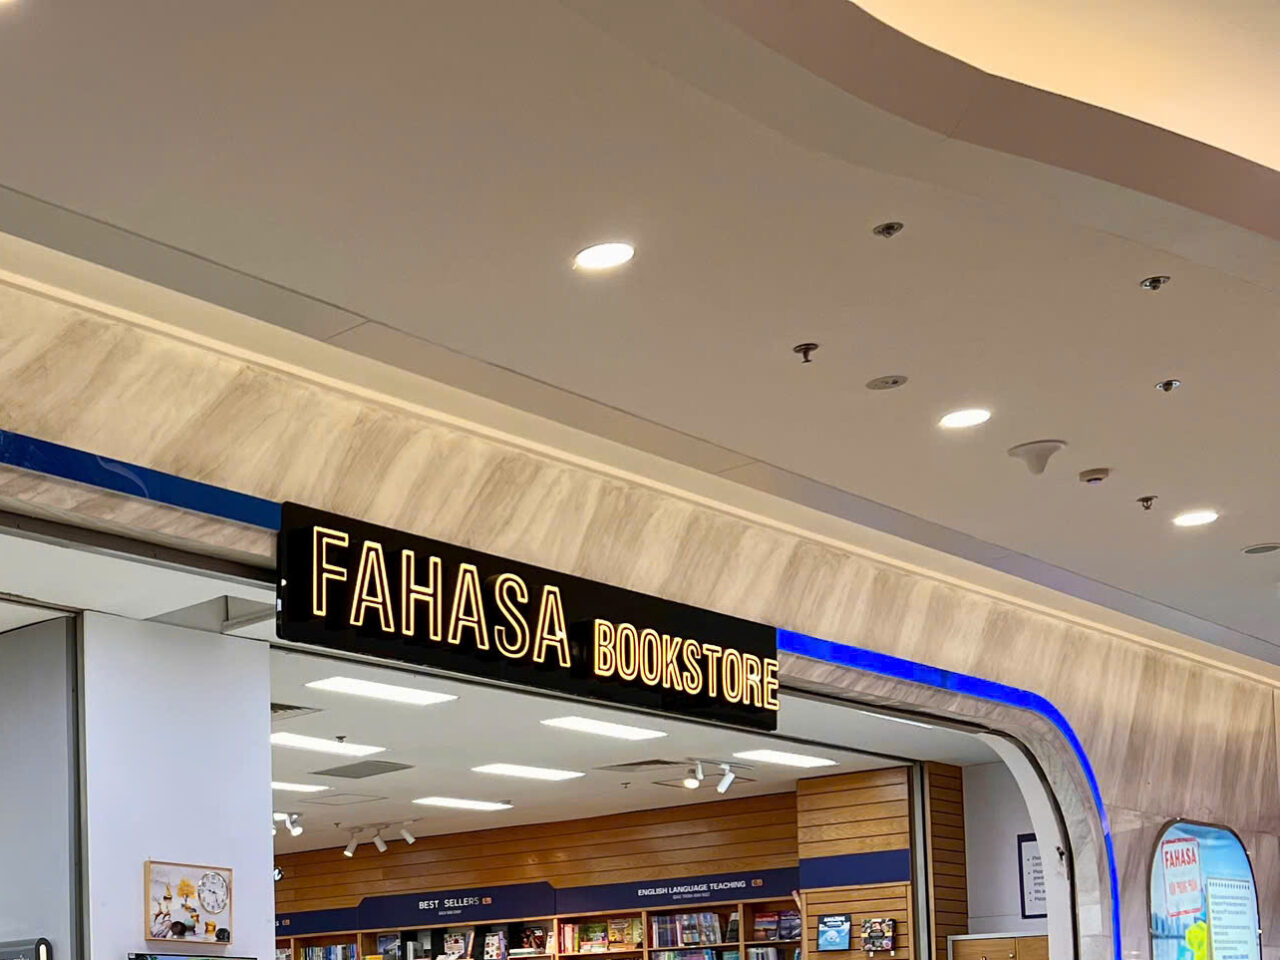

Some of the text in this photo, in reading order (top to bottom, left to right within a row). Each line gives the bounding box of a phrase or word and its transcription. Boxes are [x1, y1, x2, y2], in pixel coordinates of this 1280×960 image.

[313, 526, 780, 711] FAHASA BOOKSTORE
[1164, 847, 1197, 869] FAHASA
[638, 880, 746, 896] ENGLISH LANGUAGE TEACHING
[418, 897, 480, 910] BEST SELLERS
